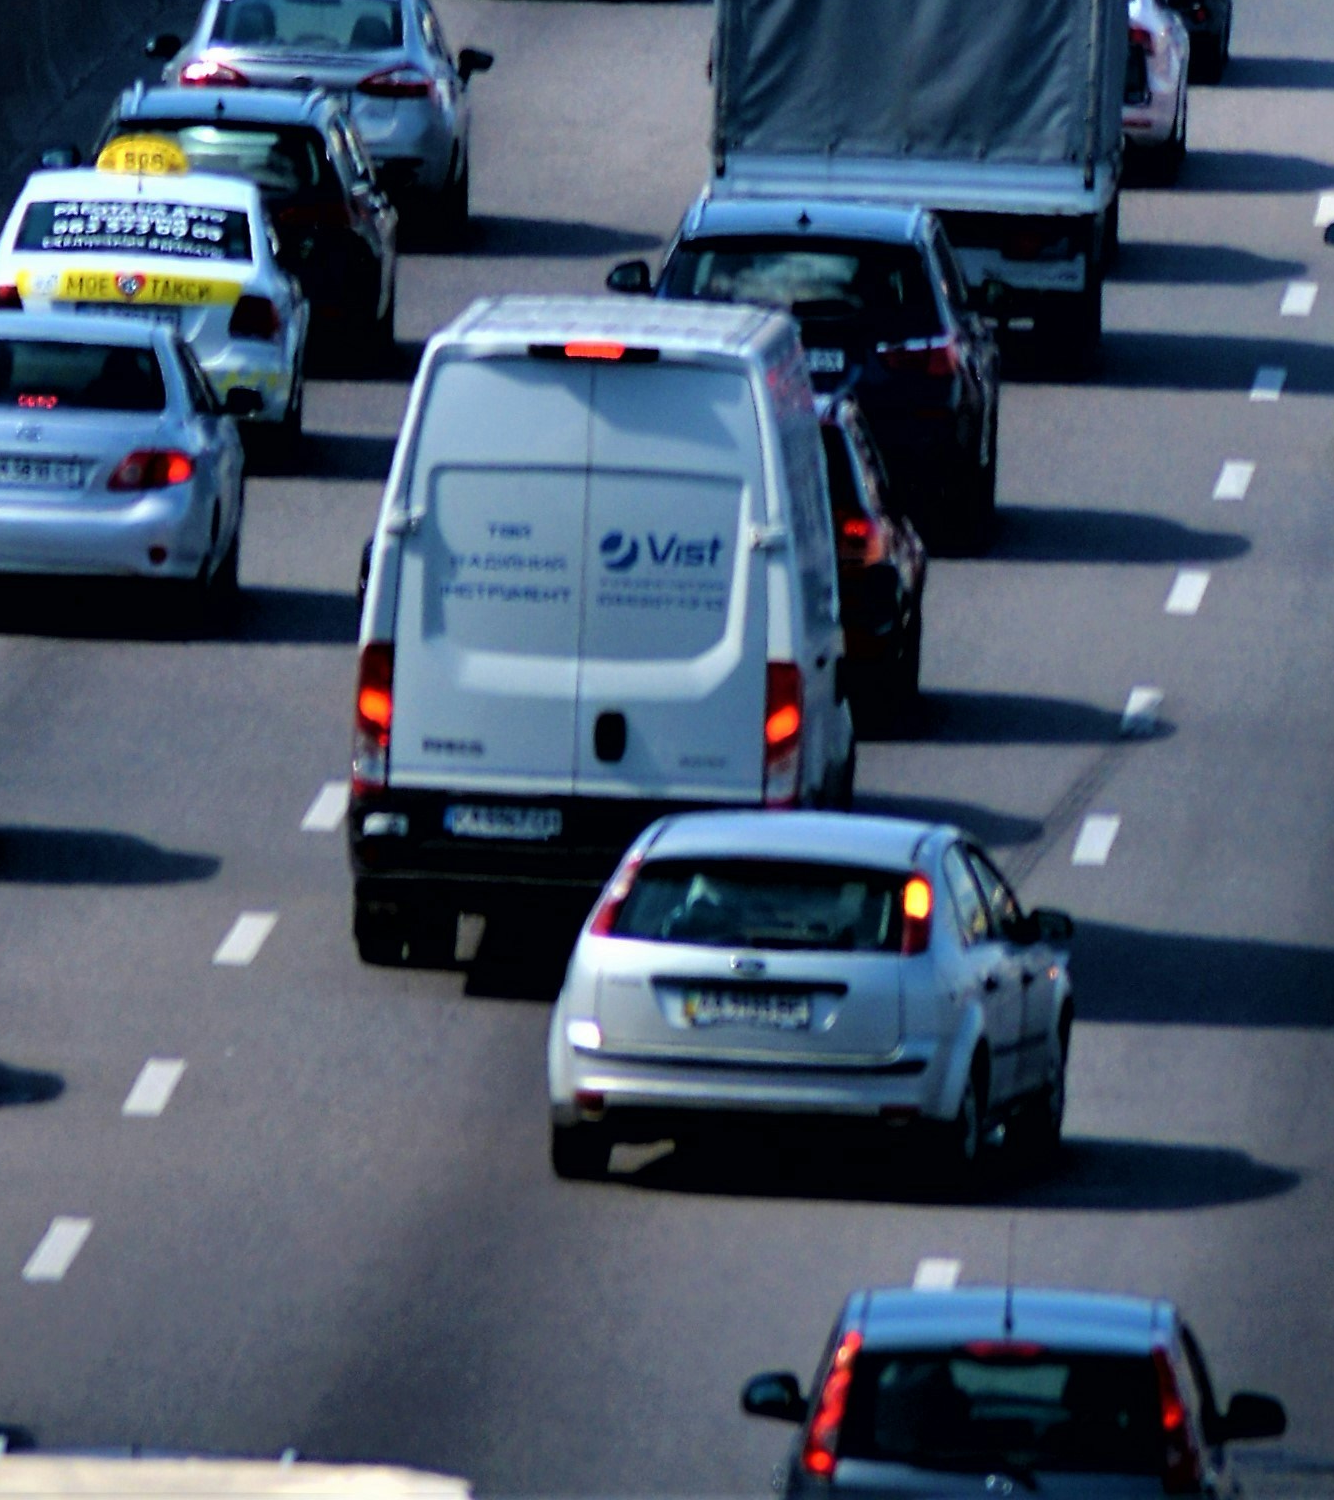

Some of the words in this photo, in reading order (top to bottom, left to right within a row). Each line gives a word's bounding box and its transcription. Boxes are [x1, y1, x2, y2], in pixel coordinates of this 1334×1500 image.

[67, 276, 109, 293] МОЕ
[151, 278, 212, 301] ТАКСИ
[648, 532, 722, 567] Vist
